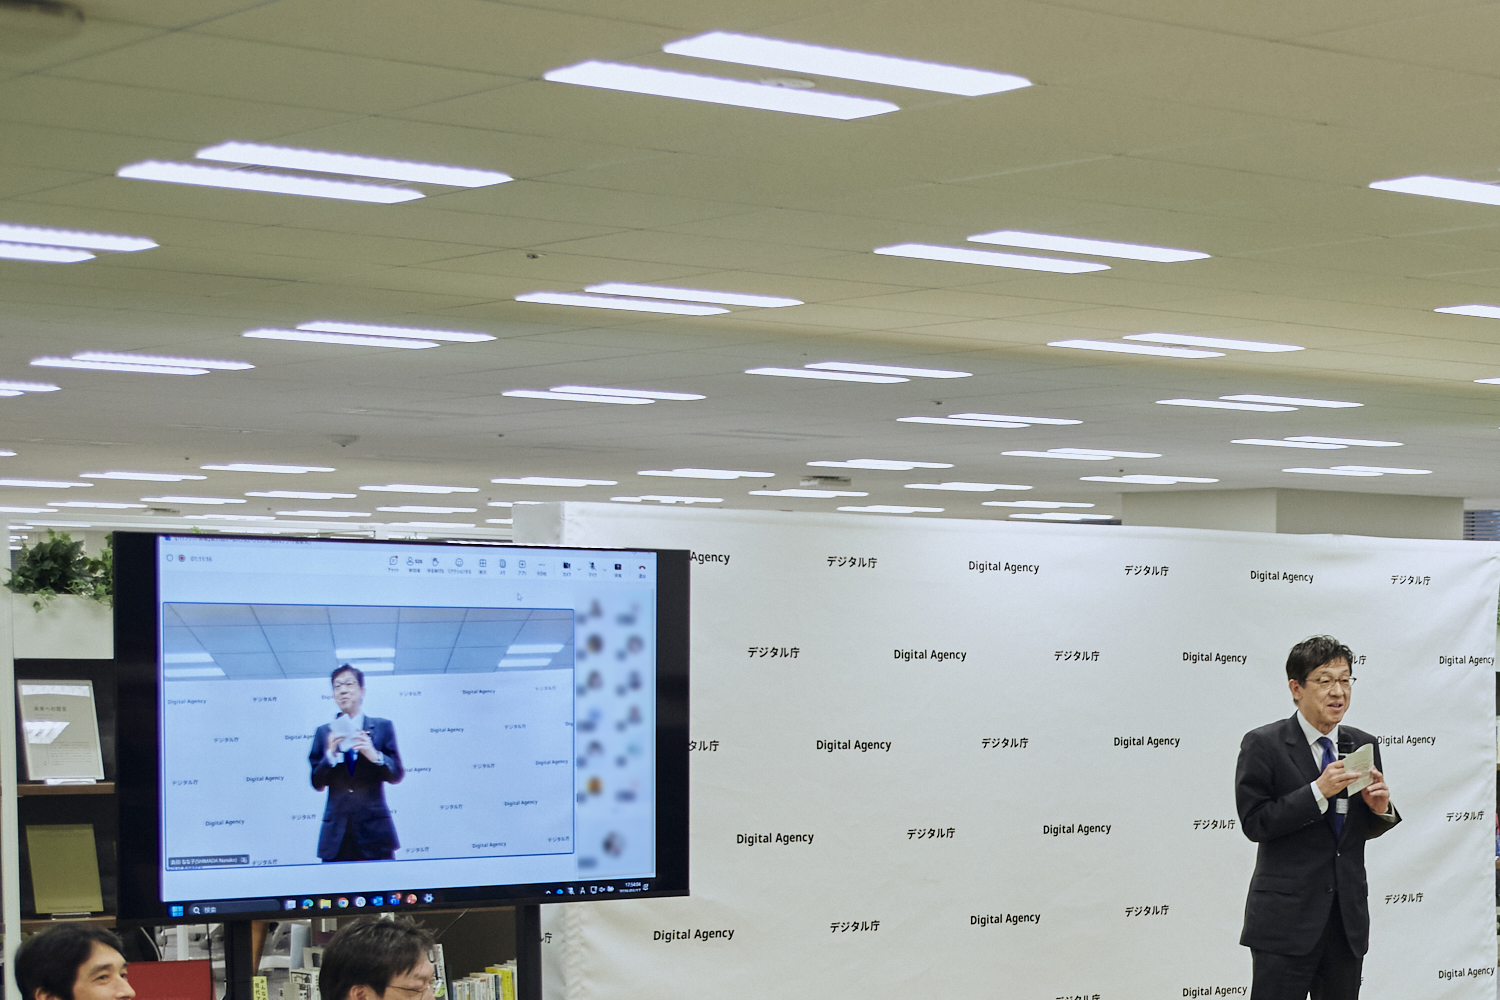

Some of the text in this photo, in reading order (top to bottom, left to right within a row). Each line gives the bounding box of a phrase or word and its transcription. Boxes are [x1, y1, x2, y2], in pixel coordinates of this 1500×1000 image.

[690, 551, 731, 565] Agency
[827, 556, 877, 568] デジタル庁
[969, 561, 1039, 574] Digital Agency
[1125, 566, 1169, 576] デジタル庁
[1251, 571, 1313, 584] Digital Agency
[1391, 575, 1430, 585] デジタル庁
[748, 647, 799, 658] デジタル庁
[894, 649, 966, 662] Digital Agency
[1055, 651, 1099, 661] デジタル庁
[1183, 652, 1247, 665] Digital Agency
[1438, 655, 1495, 667] Digital Agency
[688, 740, 720, 752] タル庁
[817, 740, 891, 752] Digital Agency
[982, 738, 1028, 748] デジタル庁
[1114, 737, 1180, 748] Digital Agency
[1377, 735, 1436, 746] Digital Agency
[1446, 811, 1484, 821] デジタル庁
[1044, 824, 1111, 836] Digital Agency
[1193, 819, 1235, 830] デジタル庁
[737, 833, 814, 846] Digital Agency
[907, 828, 955, 839] デジタル庁
[1385, 893, 1423, 904] デジタル庁
[1125, 905, 1169, 917] デジタル庁
[831, 920, 880, 933] デジタル庁
[971, 914, 1040, 927] Digital Agency
[654, 929, 734, 943] Digital Agency
[1439, 968, 1494, 980] Digital Agency
[1183, 987, 1247, 999] Digital Agency
